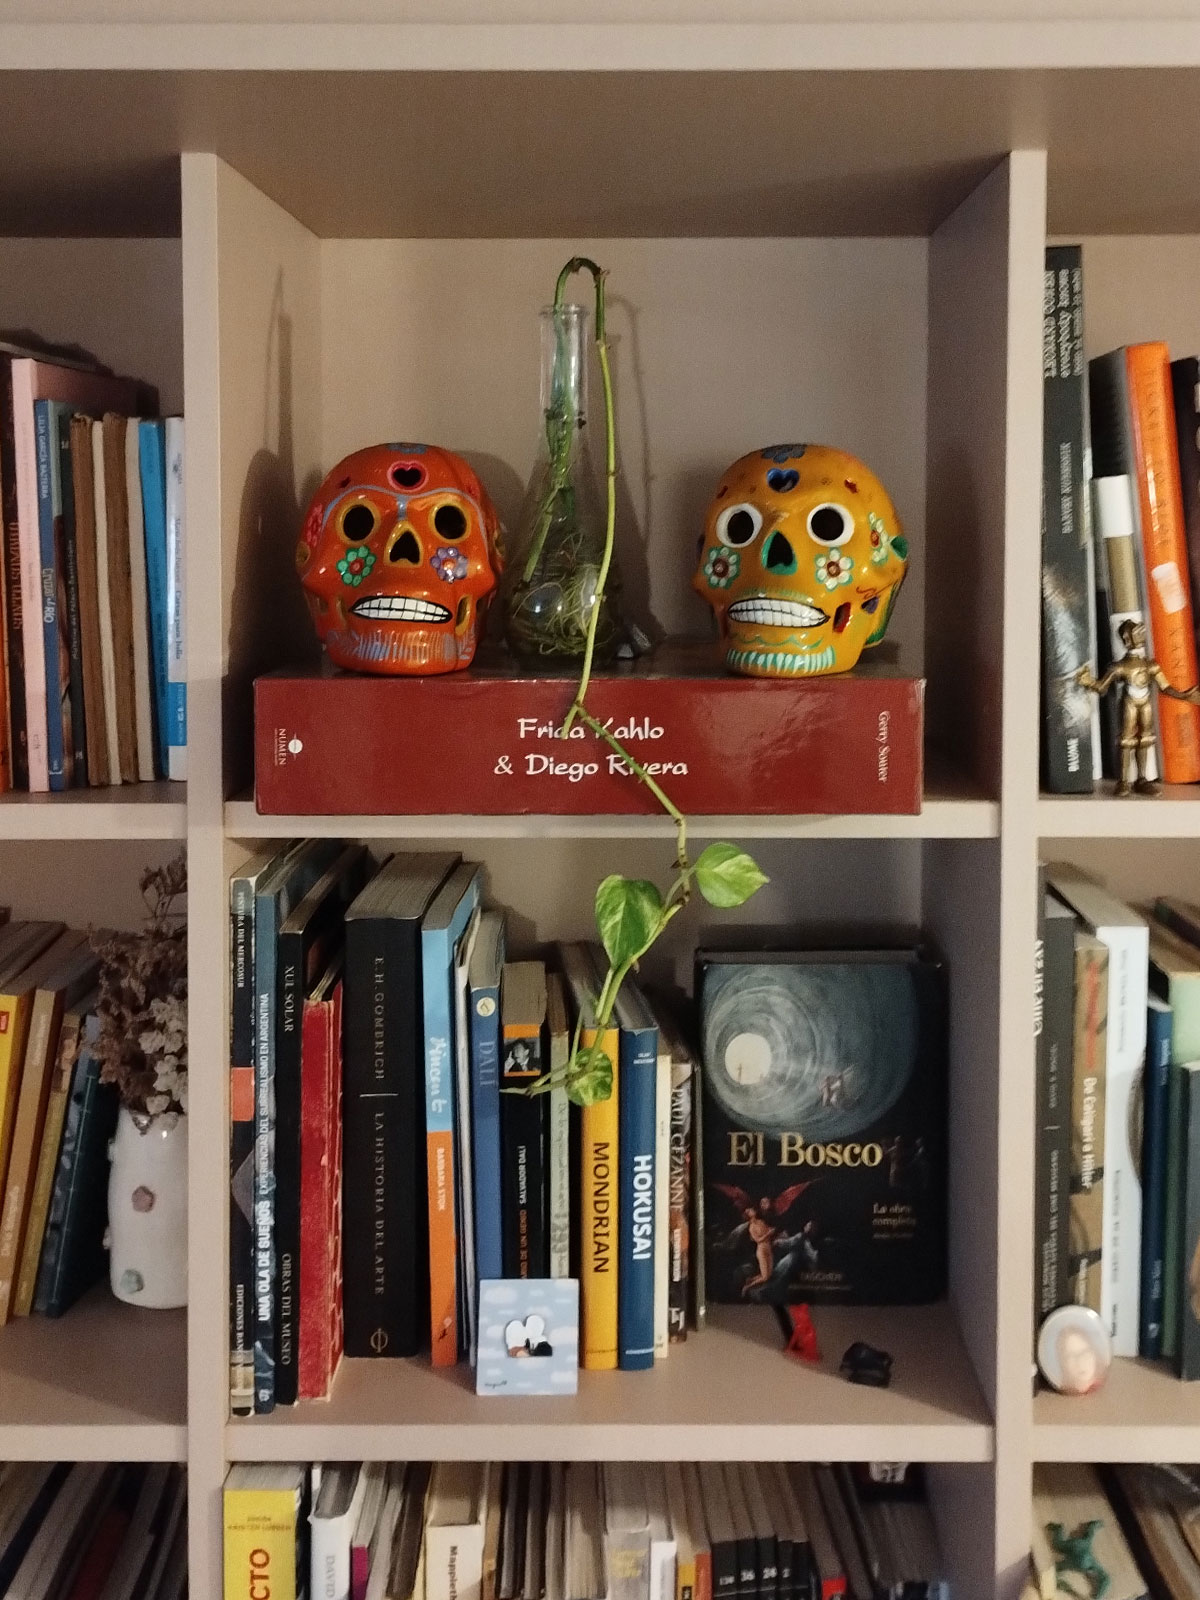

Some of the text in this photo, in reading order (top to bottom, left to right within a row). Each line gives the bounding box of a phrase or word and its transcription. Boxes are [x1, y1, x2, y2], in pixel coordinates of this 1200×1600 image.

[1056, 268, 1076, 379] everybody knows
[277, 728, 288, 766] NUMEN
[874, 710, 892, 744] Gerry
[494, 755, 514, 775] &
[524, 753, 599, 783] Diego
[1066, 737, 1080, 772] BLUME
[236, 891, 246, 989] PINTURA DEL MERCOSUR
[283, 965, 296, 1033] XUL SOLAR
[258, 993, 270, 1196] EXPERIENCIAS DEL SURREALISMO EN ARGENTINA
[670, 1087, 685, 1128] PAUL
[1083, 1077, 1098, 1096] De
[1080, 1096, 1097, 1142] Caligari
[726, 1130, 884, 1168] El Bosco
[374, 1111, 386, 1296] LA HISTORIA DEL ARTE
[518, 1165, 528, 1205] SALVADOR
[592, 1141, 611, 1274] MONDRIAN
[631, 1153, 653, 1261] HOKUSAI
[872, 1202, 888, 1215] La
[256, 1200, 273, 1322] UNA OLA DE SUEÑOS
[235, 1283, 245, 1331] EDICIONES
[281, 1252, 293, 1366] OBRAS DEL MUSEO
[248, 1548, 271, 1600] CTO
[325, 1555, 336, 1599] DAVID
